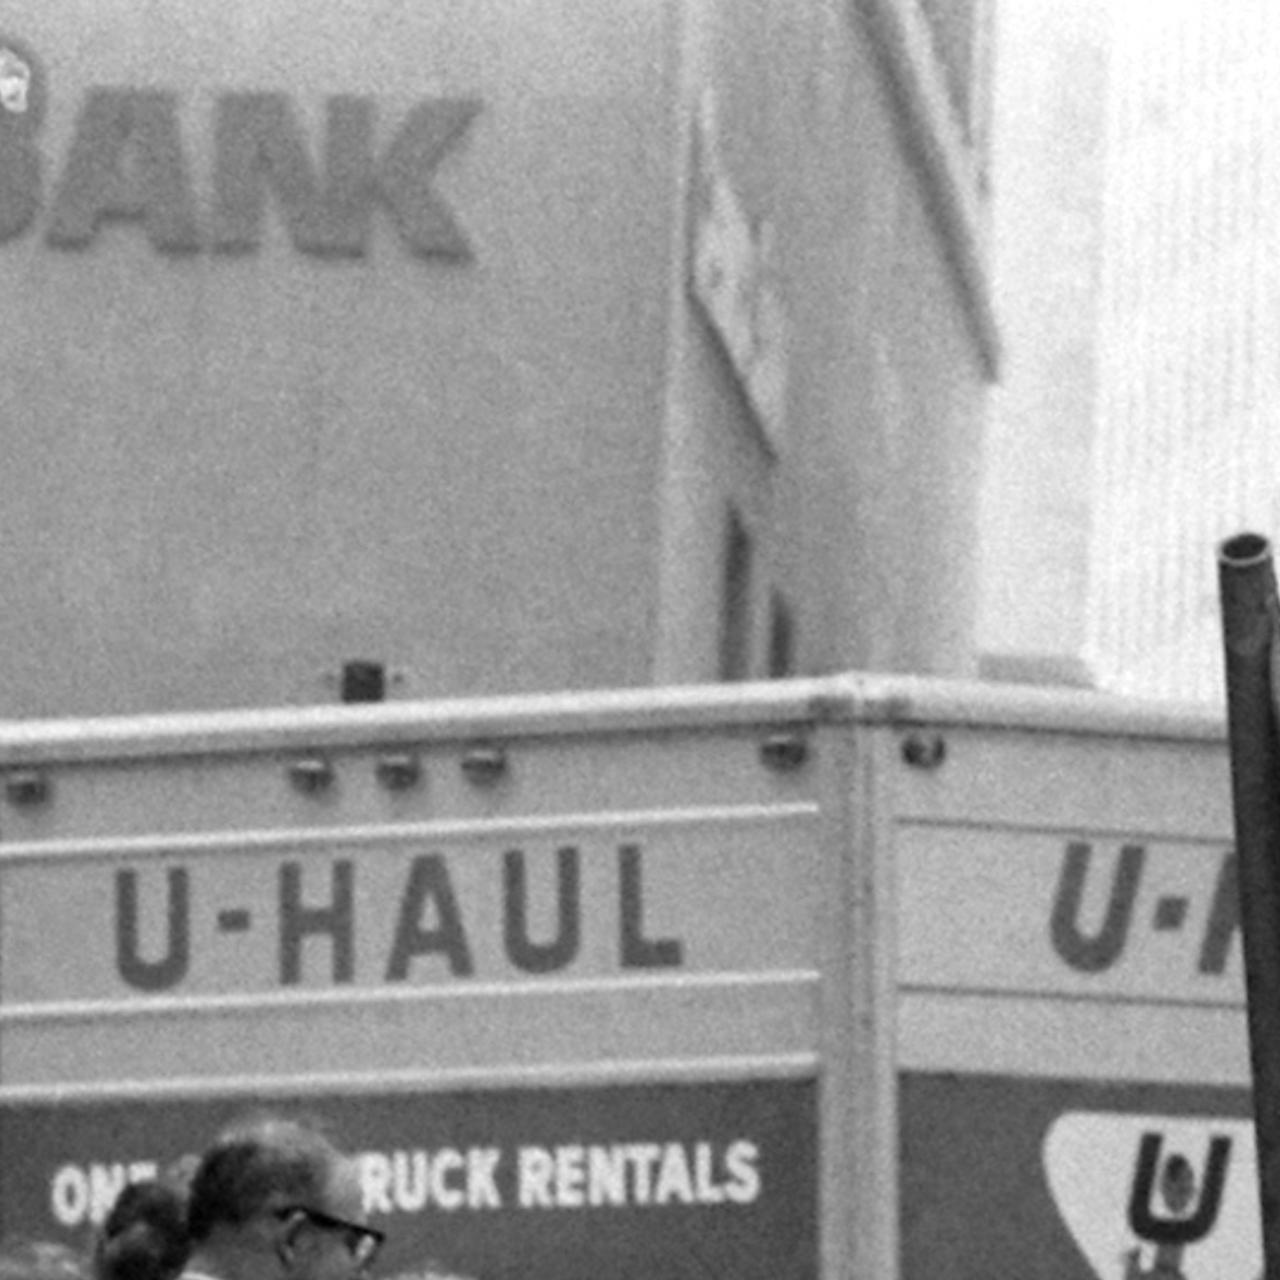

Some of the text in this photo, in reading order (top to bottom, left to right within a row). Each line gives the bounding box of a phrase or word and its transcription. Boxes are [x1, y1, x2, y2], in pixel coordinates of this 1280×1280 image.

[114, 843, 684, 991] U-HAUL
[52, 1139, 761, 1227] ON RUCK RENTALS
